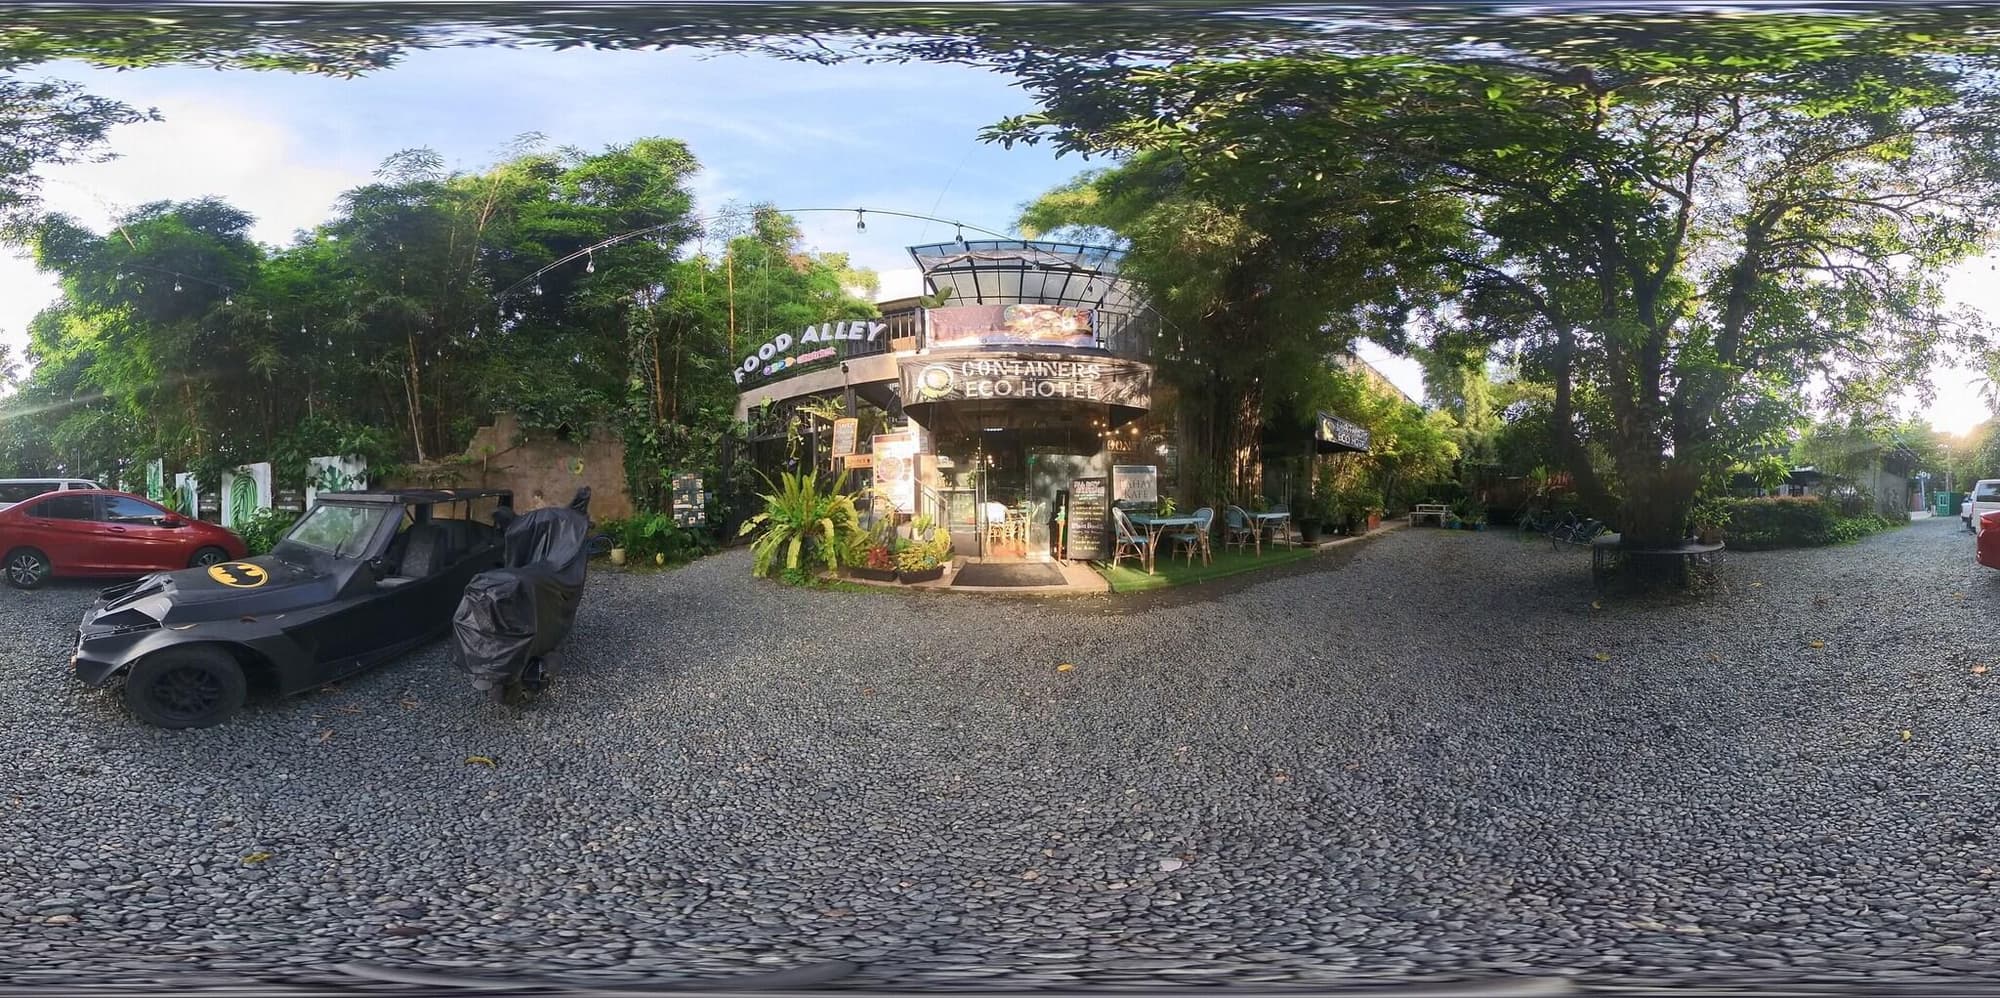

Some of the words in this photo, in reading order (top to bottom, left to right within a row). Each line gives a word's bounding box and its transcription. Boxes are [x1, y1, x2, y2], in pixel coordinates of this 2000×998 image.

[733, 333, 793, 385] FOOD
[800, 321, 888, 342] ALLEY
[961, 360, 1101, 379] CONTAINERS
[966, 380, 1012, 397] ECO
[1023, 380, 1102, 399] HOTEL
